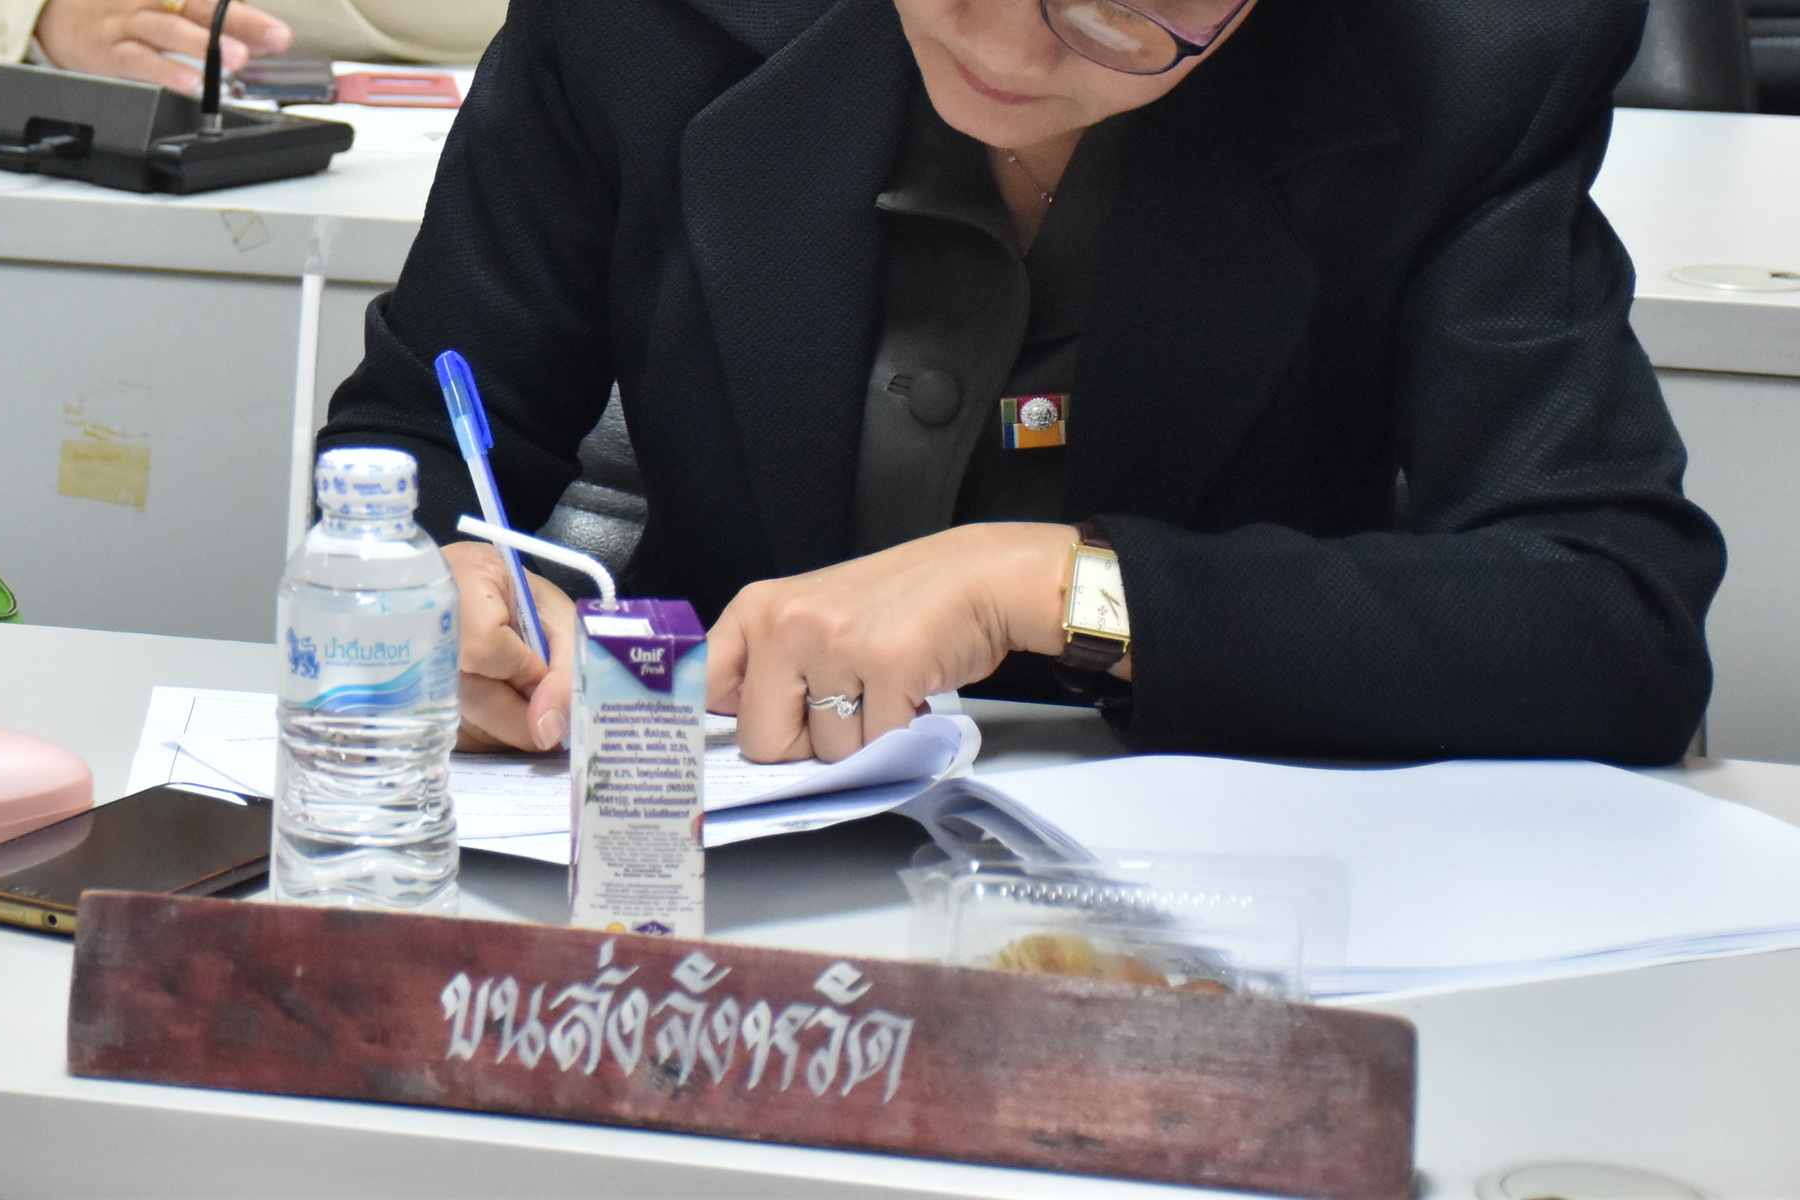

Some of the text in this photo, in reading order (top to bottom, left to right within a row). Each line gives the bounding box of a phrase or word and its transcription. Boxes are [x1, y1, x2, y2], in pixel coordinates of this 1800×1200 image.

[323, 636, 411, 661] น้ำดื่มสิงห์
[629, 647, 665, 663] Unif
[641, 663, 665, 676] fresh
[441, 938, 914, 1103] ขนส่งจังหวัด
